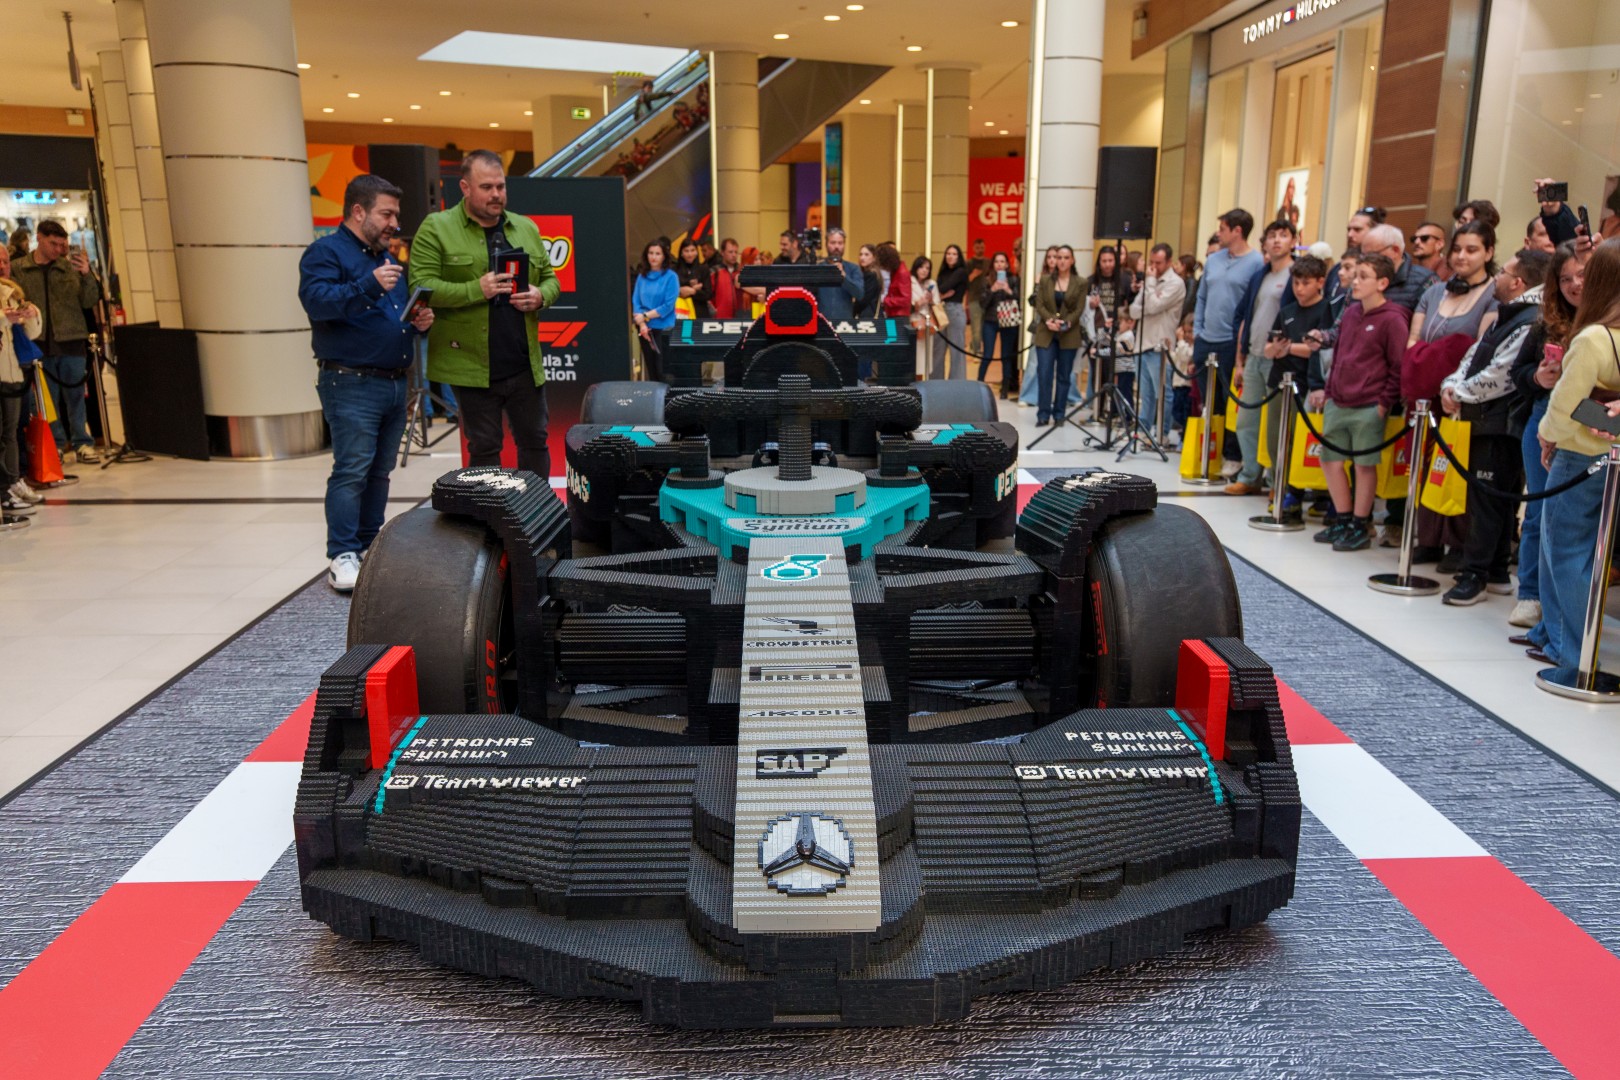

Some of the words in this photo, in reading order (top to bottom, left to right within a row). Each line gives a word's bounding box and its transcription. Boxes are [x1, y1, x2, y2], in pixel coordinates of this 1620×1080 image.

[1243, 12, 1282, 44] TOMMY
[1295, 0, 1341, 20] HILFIG
[980, 182, 1005, 196] WE
[743, 523, 850, 533] Syntium
[749, 664, 853, 681] PIRELLI
[1065, 730, 1187, 741] PETRONAS
[410, 737, 535, 748] PETRONAS
[1091, 742, 1196, 755] Syntium
[402, 749, 508, 762] Syntium
[757, 750, 831, 776] SAP
